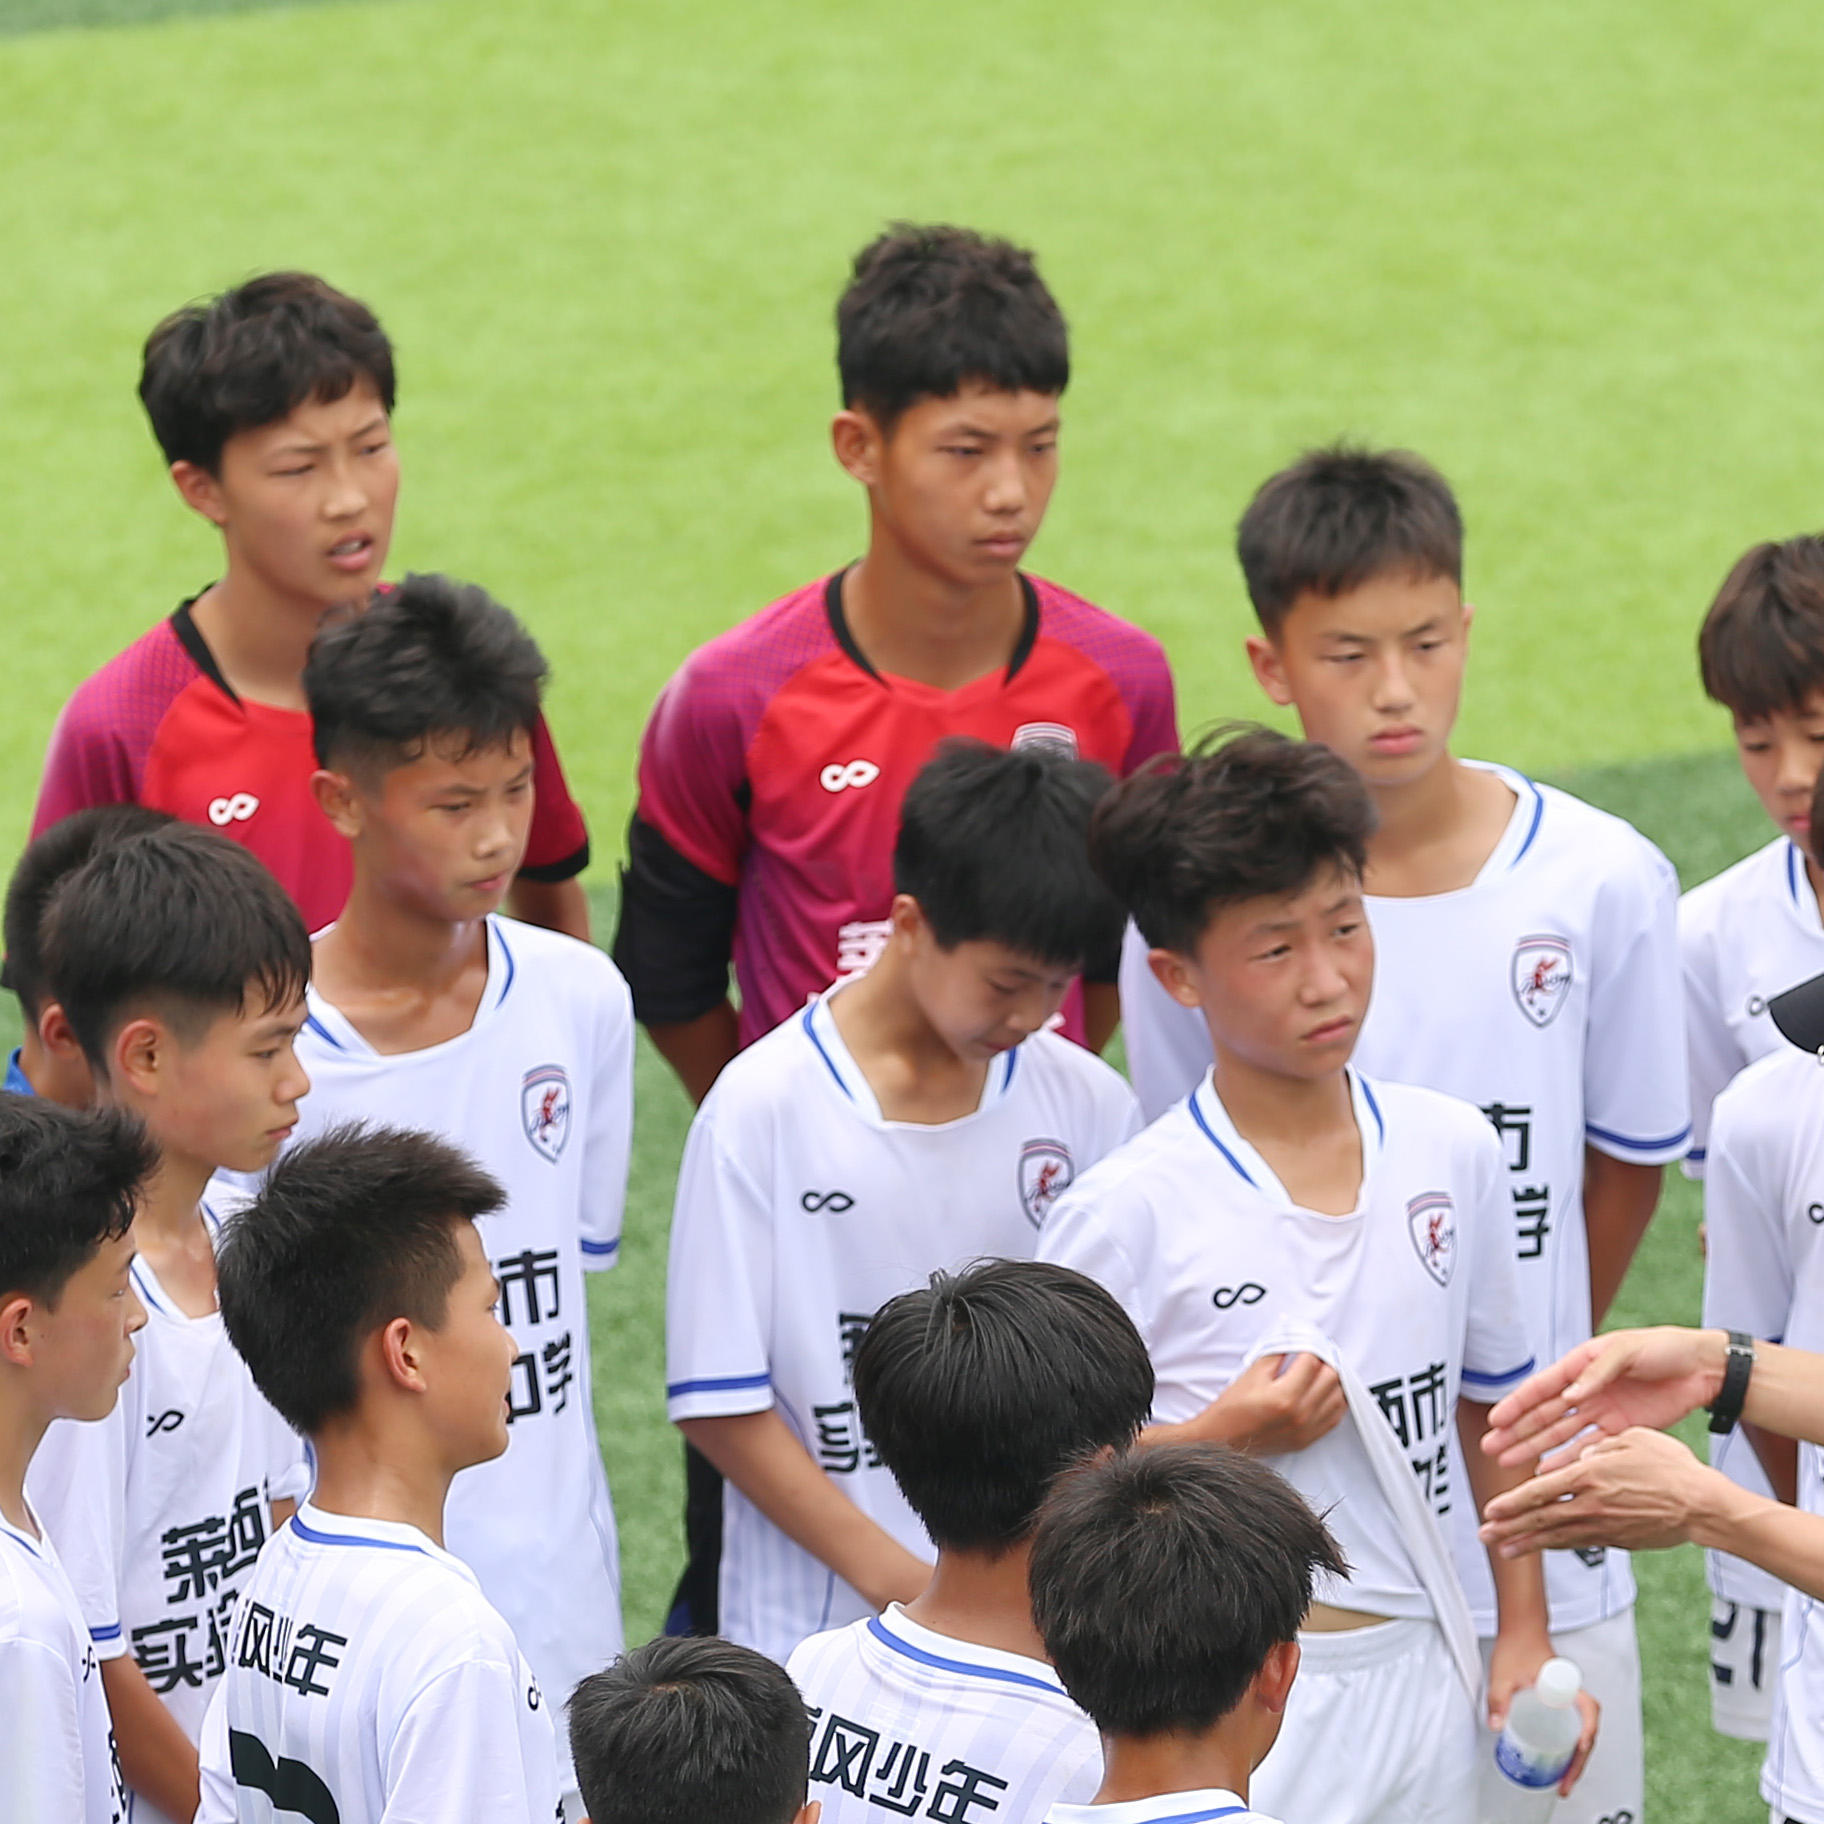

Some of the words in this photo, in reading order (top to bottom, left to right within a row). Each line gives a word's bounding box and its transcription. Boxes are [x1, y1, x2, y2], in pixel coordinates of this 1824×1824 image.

[489, 1249, 560, 1326] 市
[161, 1474, 270, 1605] 莱西
[231, 1599, 348, 1697] 风少年
